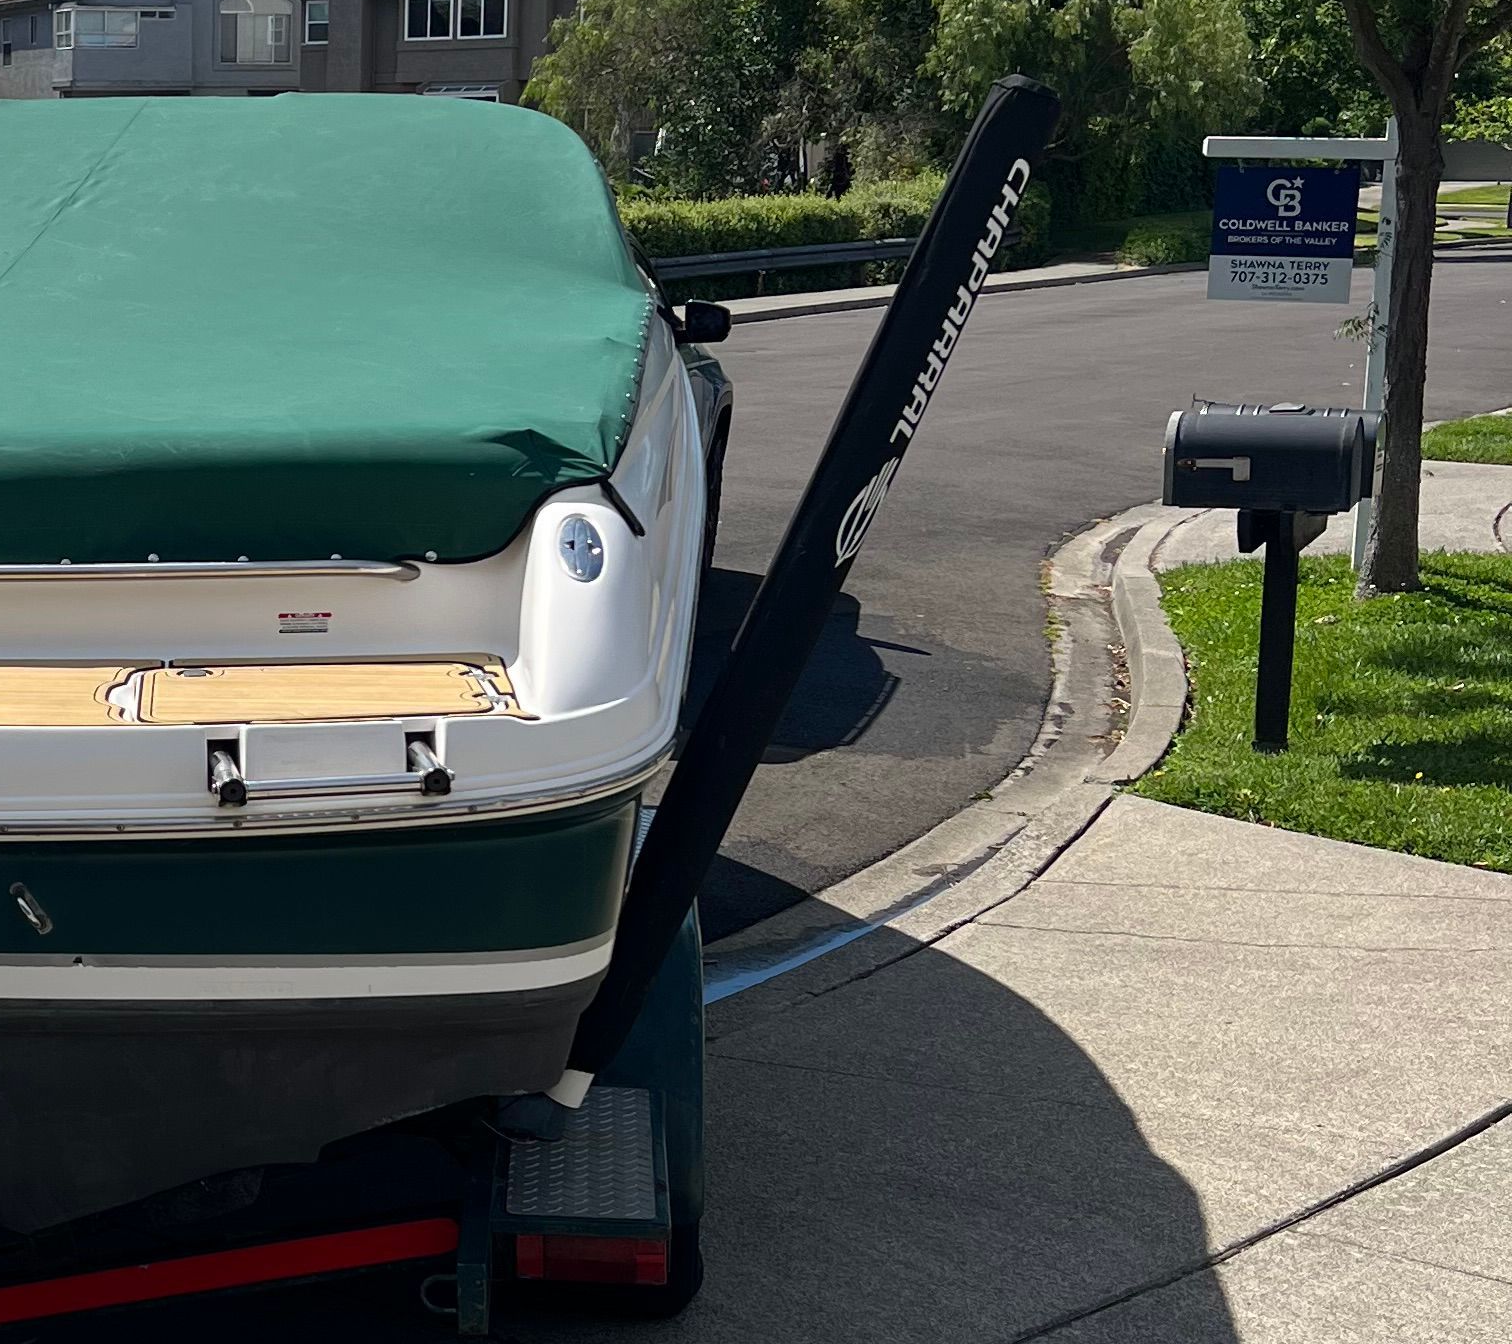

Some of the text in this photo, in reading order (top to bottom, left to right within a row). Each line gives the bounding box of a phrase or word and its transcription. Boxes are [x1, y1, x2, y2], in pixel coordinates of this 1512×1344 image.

[1219, 219, 1349, 232] COLDWELL BANKER
[1227, 235, 1338, 246] BROKERS OF THE VALLEY
[1231, 259, 1330, 271] SHAWNA TERRY
[1230, 271, 1329, 285] 707-312-0375
[890, 158, 1031, 445] CHAPARRAL
